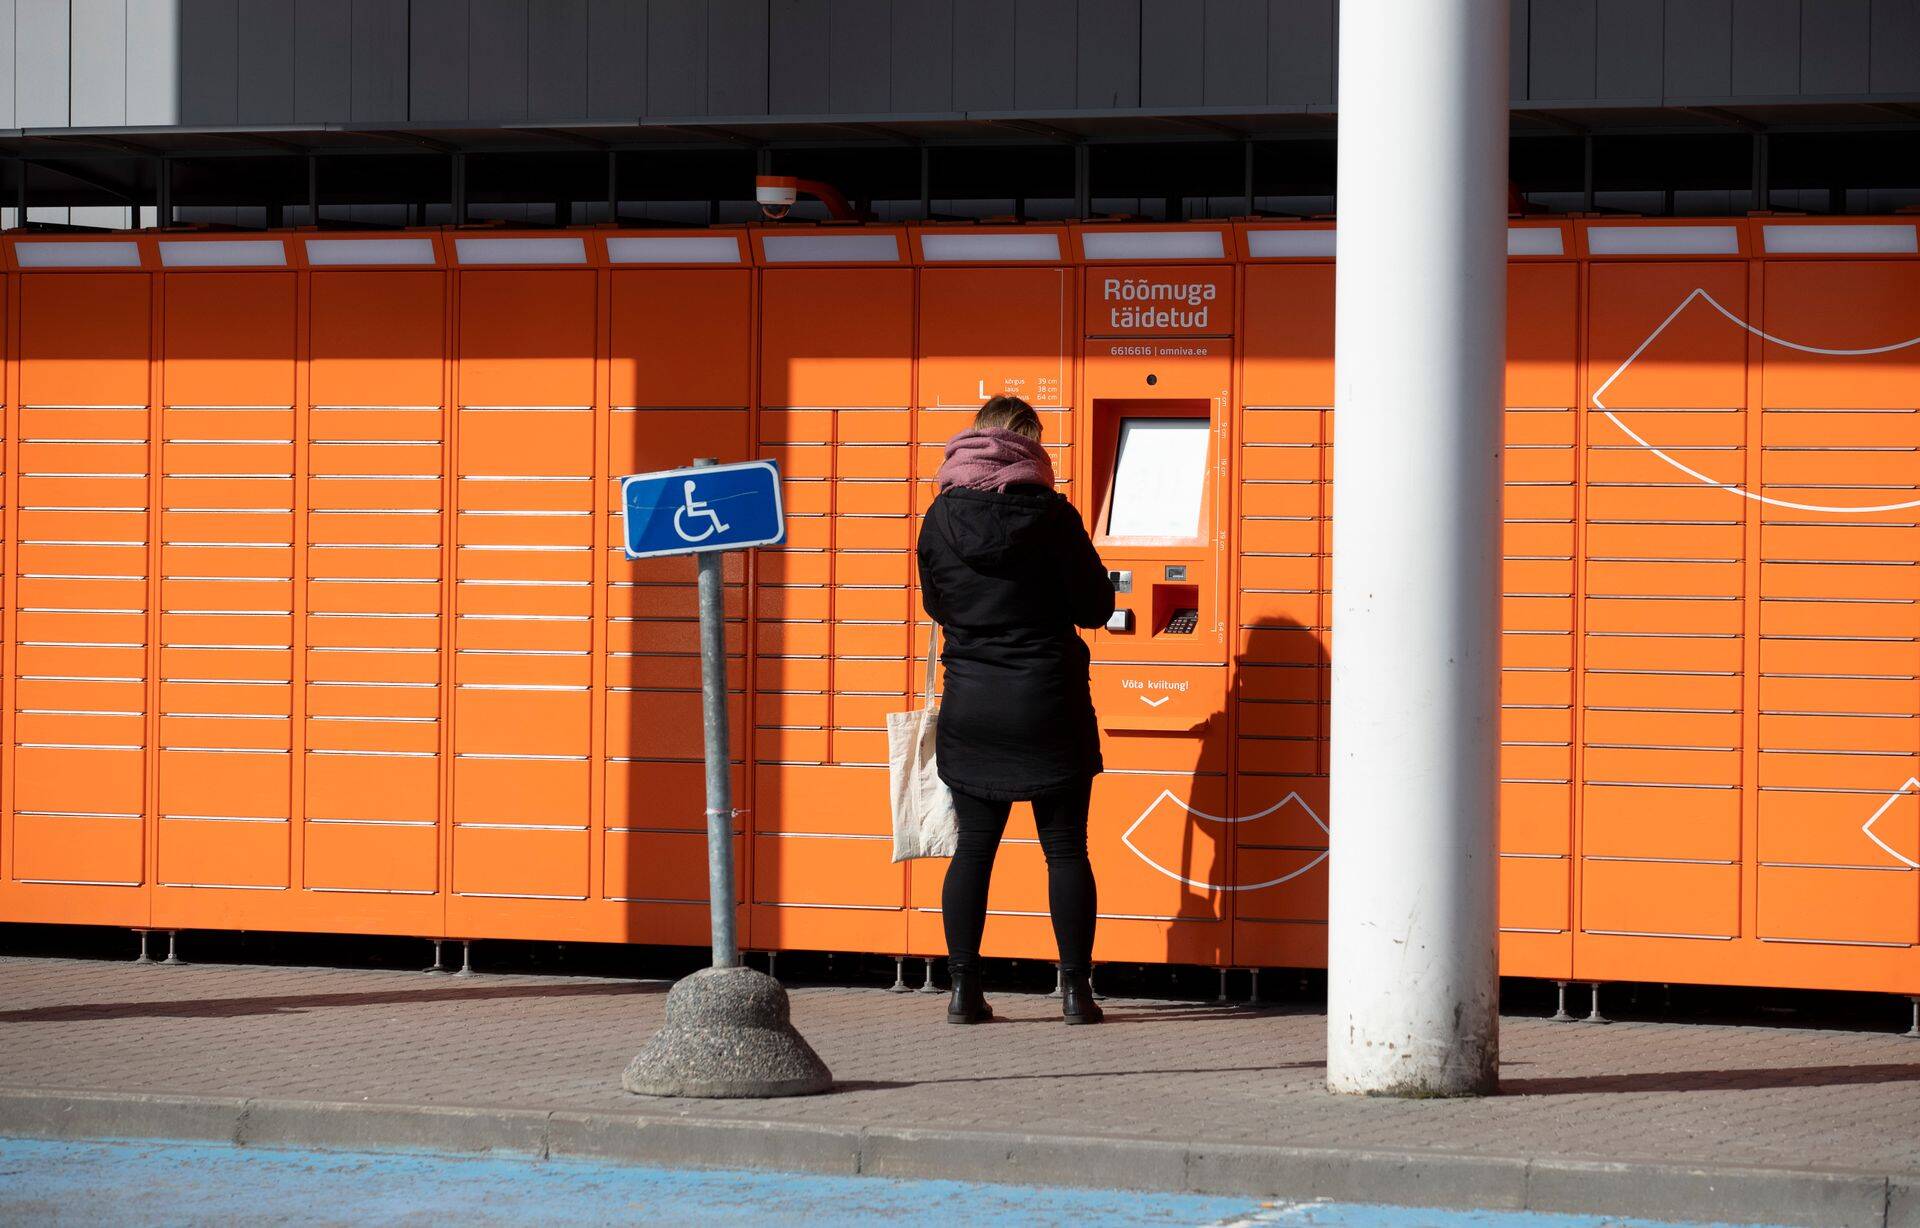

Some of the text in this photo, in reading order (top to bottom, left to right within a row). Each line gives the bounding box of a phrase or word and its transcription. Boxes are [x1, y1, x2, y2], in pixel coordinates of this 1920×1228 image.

[1104, 279, 1216, 305] Rõõmuga
[1111, 306, 1208, 328] täidetud
[1110, 346, 1152, 355] 6616616
[1159, 346, 1208, 356] omniva.ee
[979, 380, 991, 399] L
[1121, 679, 1144, 689] Võta
